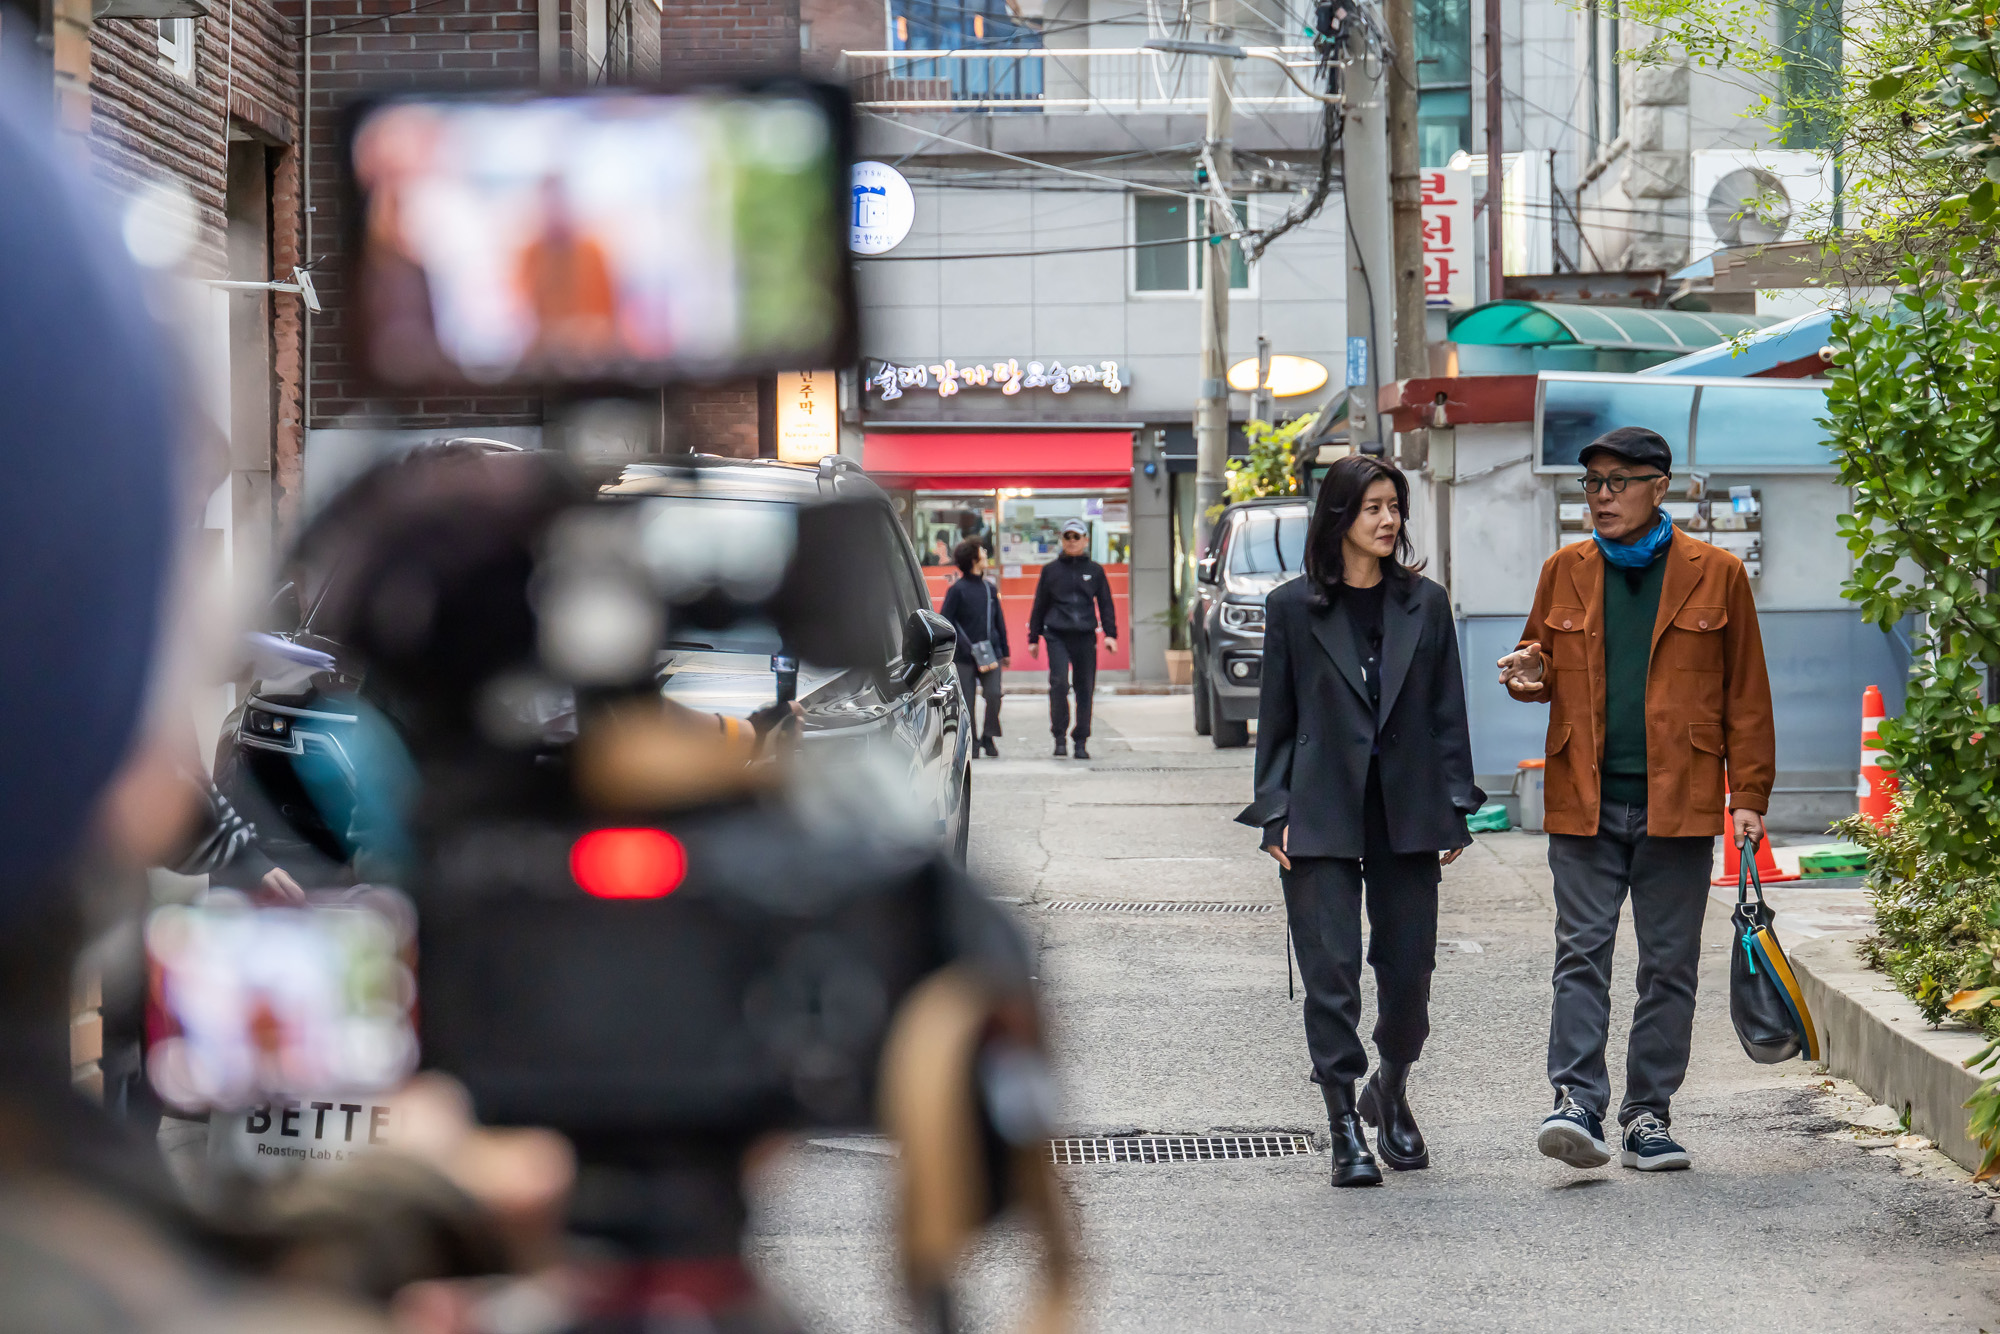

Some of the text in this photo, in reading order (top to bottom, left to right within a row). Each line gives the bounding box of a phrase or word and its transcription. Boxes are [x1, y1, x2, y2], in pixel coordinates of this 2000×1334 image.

[246, 1100, 394, 1144] BETTE
[258, 1143, 306, 1160] Roasting
[310, 1148, 331, 1160] Lab
[335, 1150, 344, 1161] &
